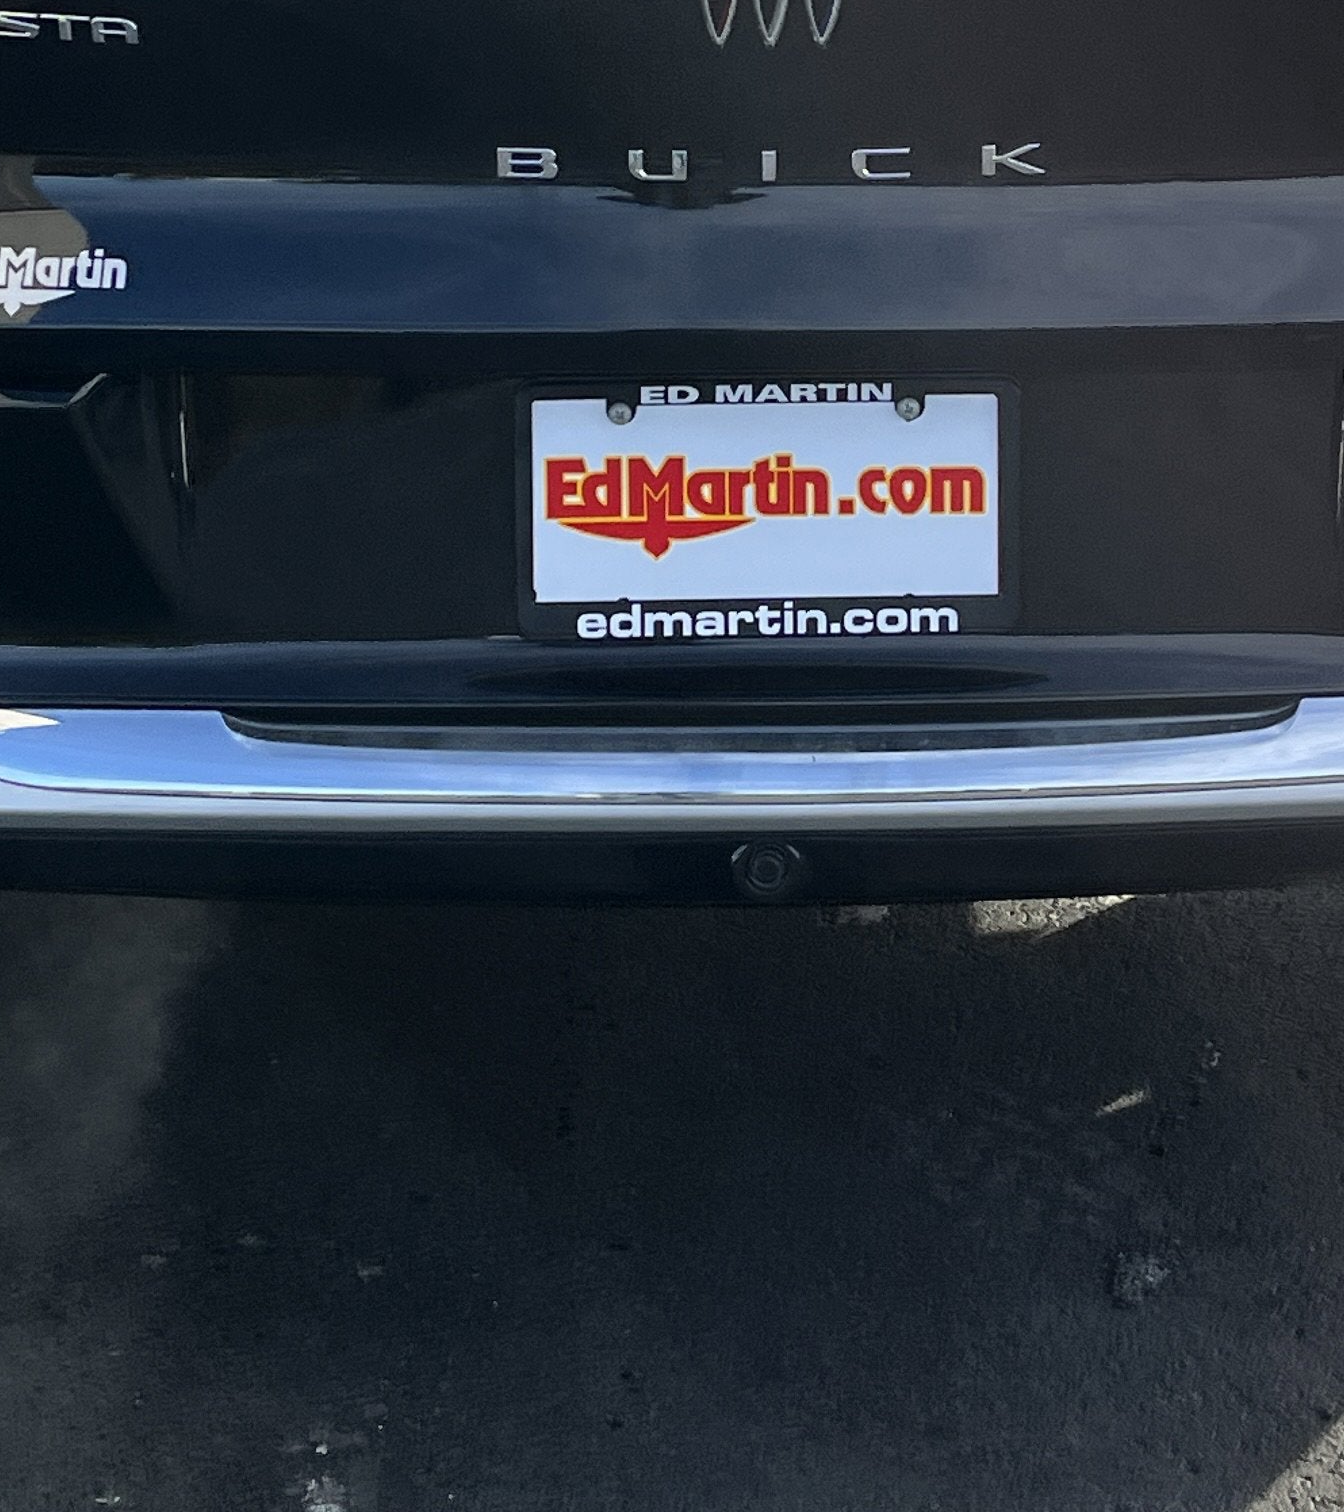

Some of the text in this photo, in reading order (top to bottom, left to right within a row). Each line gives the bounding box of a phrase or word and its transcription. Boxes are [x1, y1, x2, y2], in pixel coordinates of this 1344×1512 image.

[496, 142, 1046, 182] BUICK
[639, 382, 893, 405] ED MARTIN
[576, 600, 960, 639] edmartin.com
